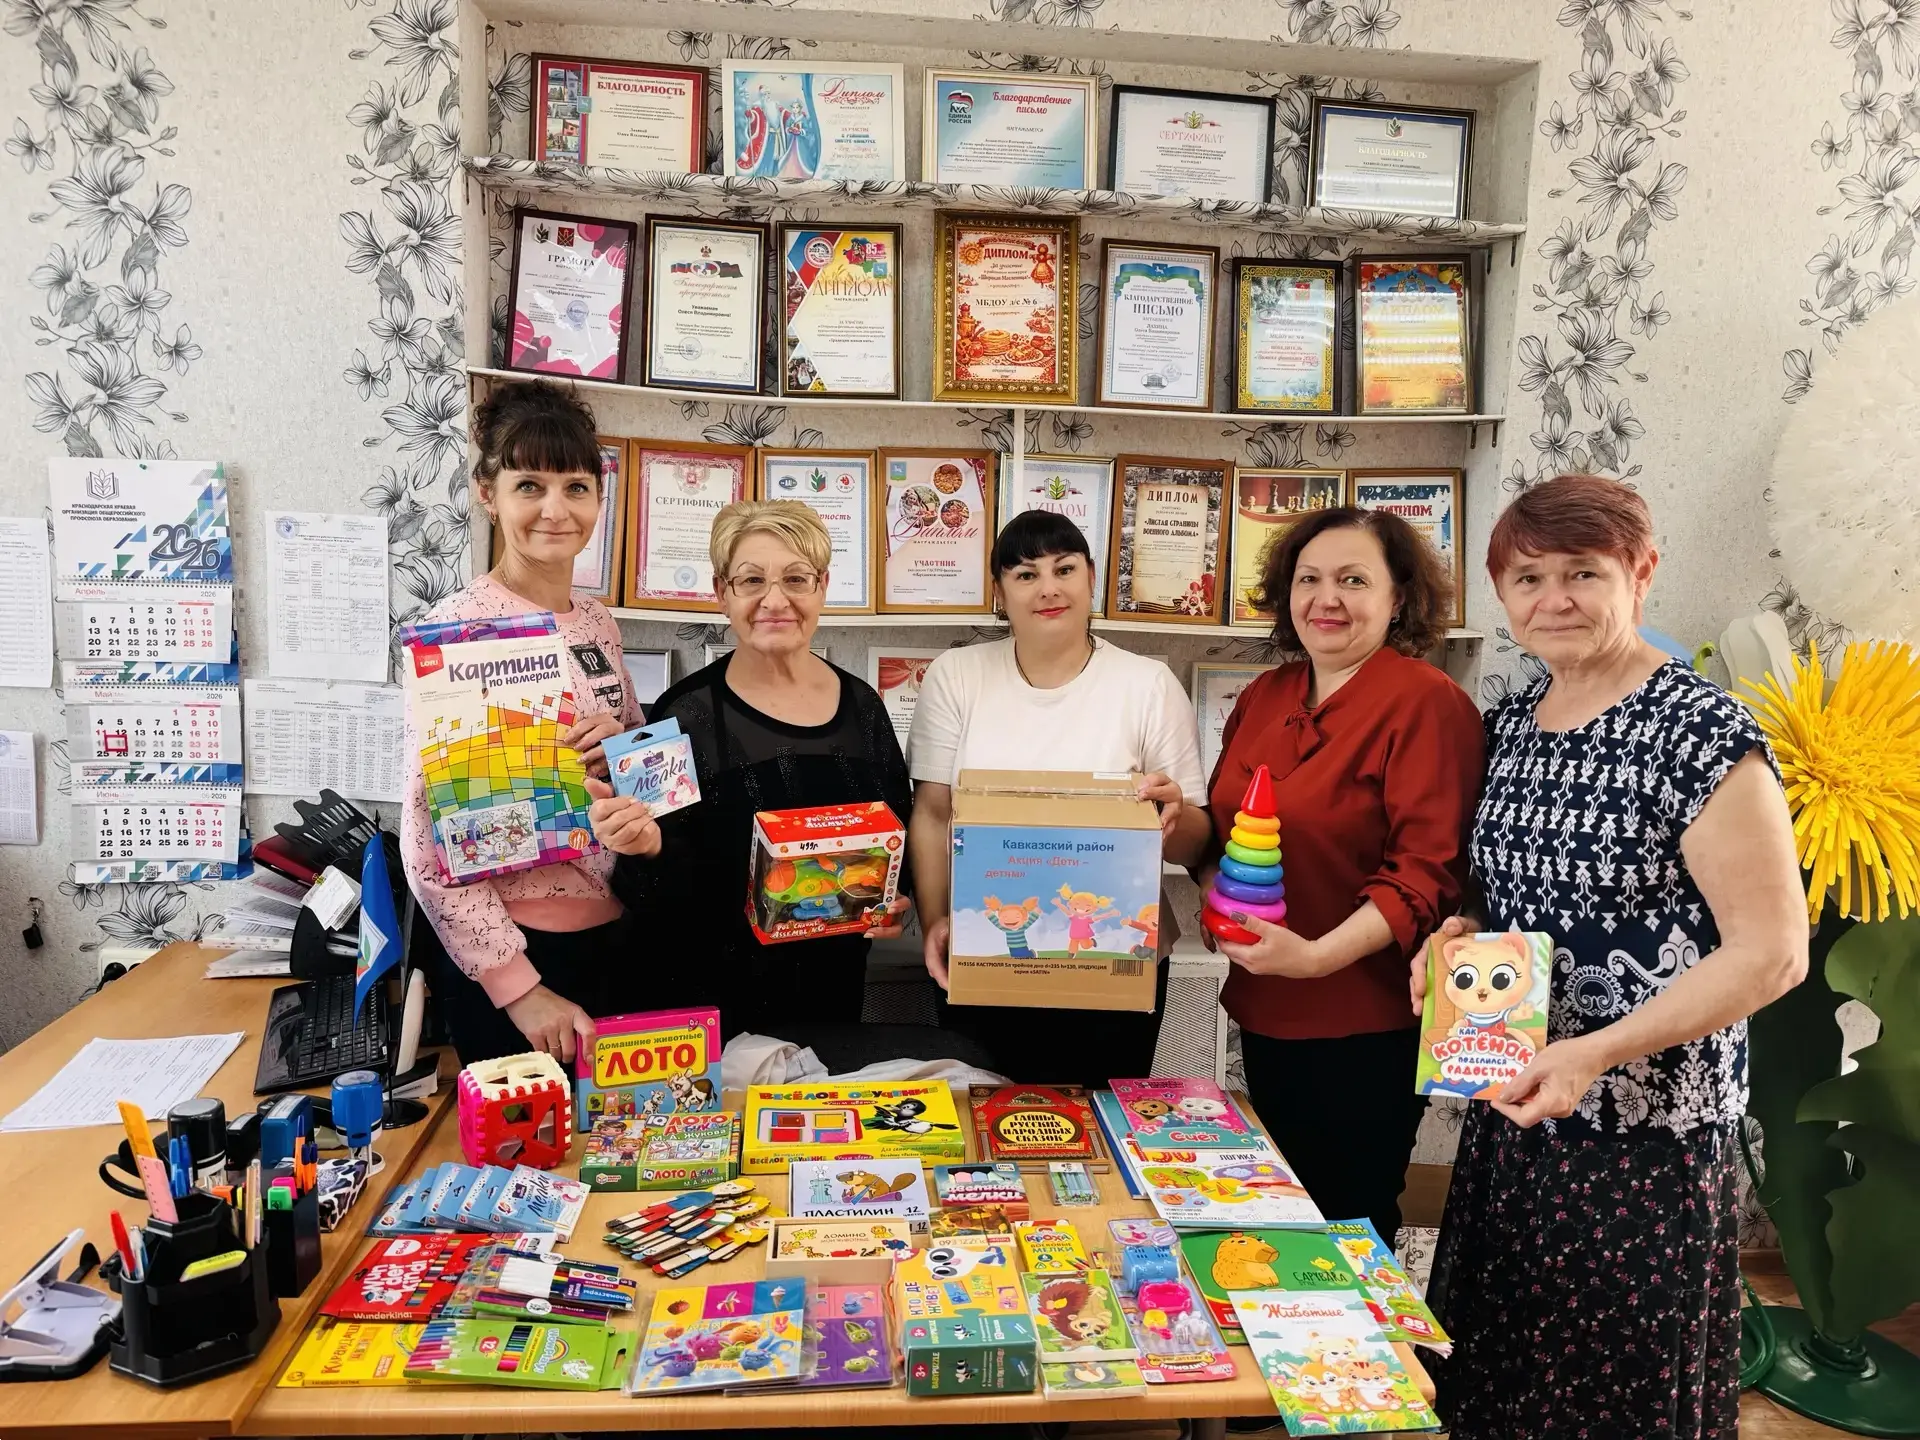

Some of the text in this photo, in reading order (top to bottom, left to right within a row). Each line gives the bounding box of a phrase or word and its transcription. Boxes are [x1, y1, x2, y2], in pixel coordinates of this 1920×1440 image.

[597, 81, 686, 96] БЛАГОДАРНОСТЬ
[818, 77, 886, 98] Диплом
[992, 91, 1072, 105] Благодарственное
[1016, 104, 1048, 114] письмо
[1159, 131, 1225, 144] СЕРТИФИКАТ
[1358, 145, 1428, 159] БЛАГОДАРНОСТЬ
[866, 243, 878, 254] 85
[984, 248, 1028, 260] ДИПЛОМ
[813, 278, 887, 296] ДИПЛОМ
[976, 298, 1038, 306] МБДОУ д/с № 6
[1124, 294, 1194, 305] БЛАГОДАРСТВЕННОЕ
[1133, 304, 1184, 316] ПИСЬМО
[656, 496, 726, 509] СЕРТИФИКАТ
[1147, 490, 1198, 504] ДИПЛОМ
[890, 515, 978, 542] Диплом
[1170, 518, 1199, 528] СТРАНИЦЫ
[1143, 528, 1170, 536] ВОЕННОГО
[151, 523, 221, 571] 2026
[914, 560, 956, 568] УЧАСТНИК
[75, 588, 106, 596] Апрель
[449, 652, 559, 682] Картина
[490, 670, 560, 688] по номерам
[632, 756, 688, 796] мелки
[1002, 839, 1114, 852] Кавказский район
[1008, 856, 1043, 868] Акция
[1046, 857, 1079, 867] «Дети
[984, 868, 1026, 880] детям»
[598, 1032, 703, 1051] Домашние животные
[1433, 1033, 1535, 1066] КОТЁНОК
[605, 1044, 696, 1078] ЛОТО
[1458, 1057, 1506, 1065] ПОДЕЛИЛСЯ
[1447, 1064, 1518, 1077] РАДОСТЬЮ
[760, 1087, 938, 1100] ВЕСЁЛОЕ ОБУЧЕНИЕ
[647, 1115, 668, 1126] IQ
[668, 1114, 728, 1126] ЛОТО
[684, 1129, 726, 1138] Жукова
[1170, 1132, 1220, 1142] Счёт
[750, 1156, 784, 1164] ВЕСЁЛОЕ
[1219, 1153, 1257, 1161] ЛОГИКА
[643, 1169, 654, 1180] IQ
[655, 1170, 686, 1180] ЛОТО
[947, 1190, 1024, 1201] мелки
[802, 1208, 894, 1218] ПЛАСТИЛИН
[917, 1222, 926, 1230] 12
[1025, 1233, 1072, 1242] КРОХА
[1292, 1271, 1348, 1282] CAPYBARA
[583, 1289, 633, 1301] Фломастеры
[909, 1298, 924, 1316] КТО
[1262, 1302, 1344, 1319] Животные
[1403, 1316, 1425, 1329] 35
[914, 1328, 926, 1338] 3+
[482, 1339, 492, 1349] 12
[916, 1366, 926, 1378] 3+
[932, 1352, 940, 1389] BABYPUZZLE
